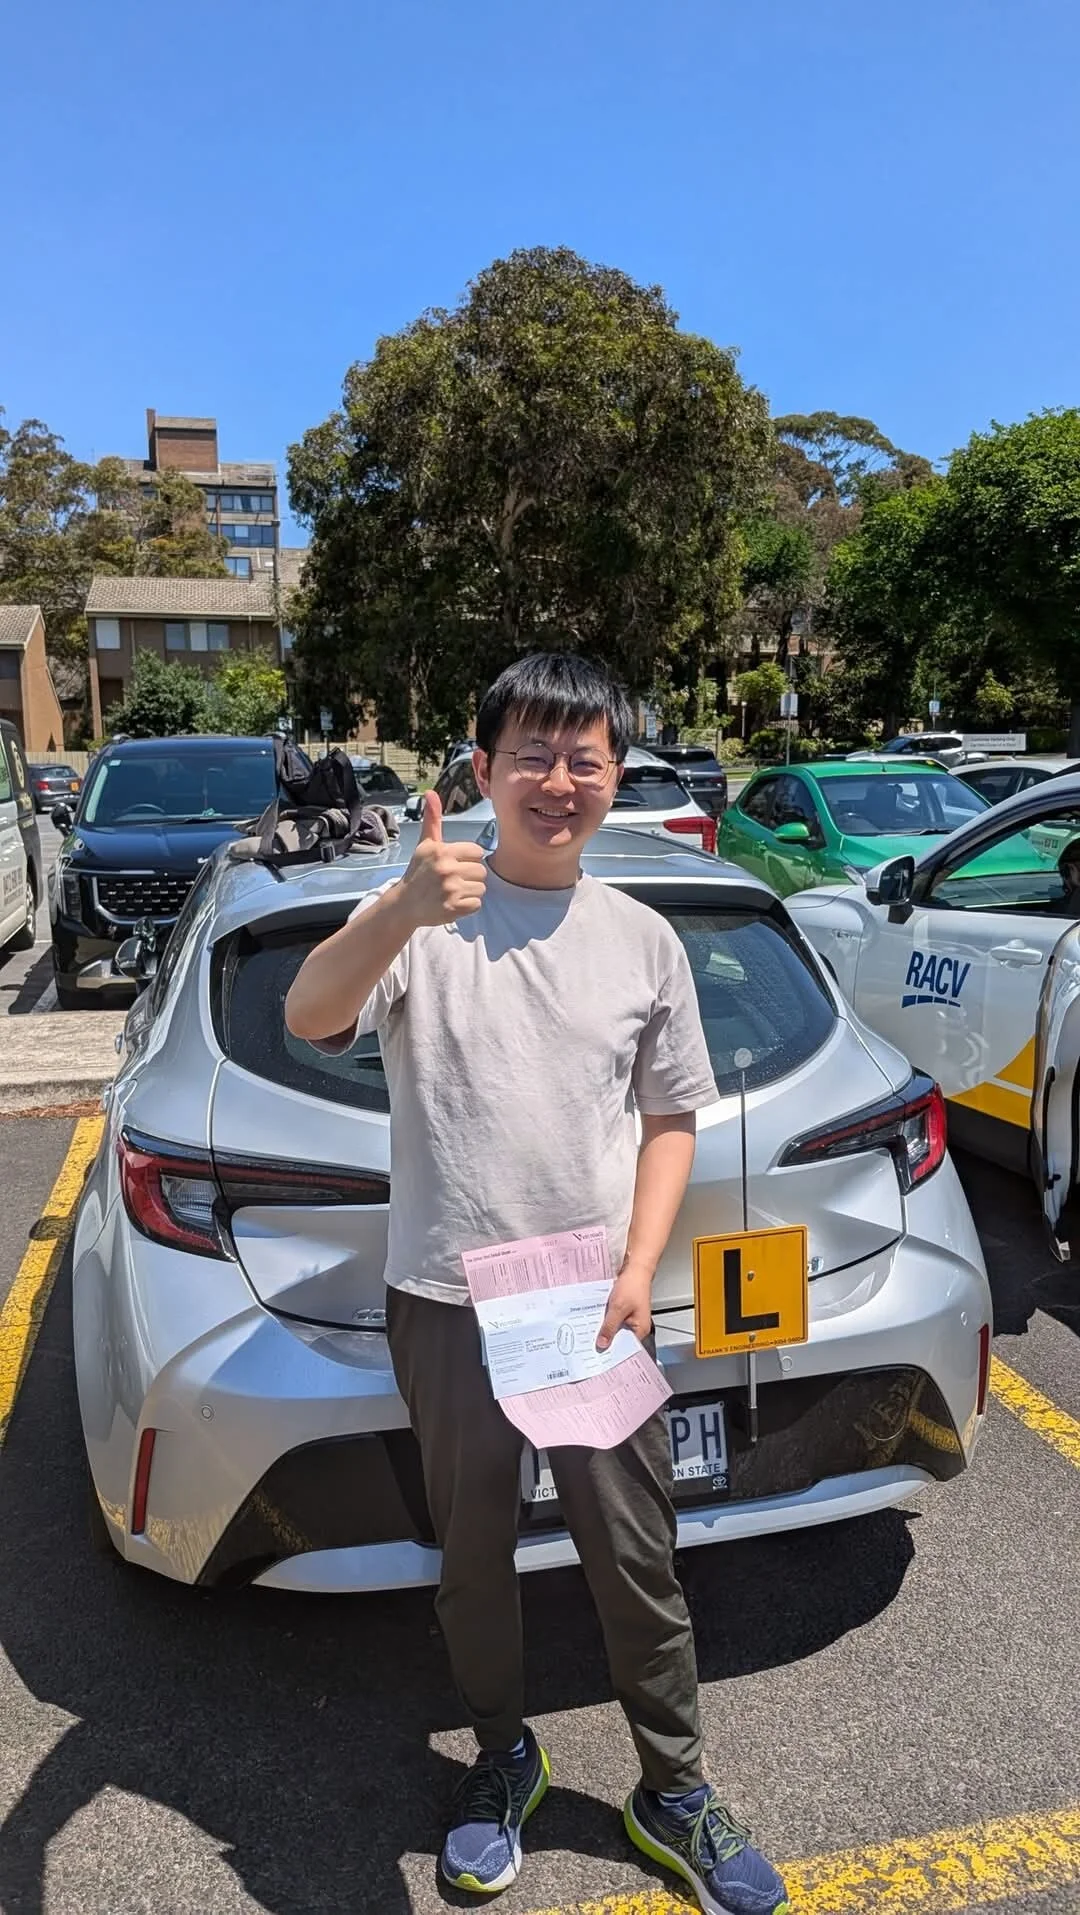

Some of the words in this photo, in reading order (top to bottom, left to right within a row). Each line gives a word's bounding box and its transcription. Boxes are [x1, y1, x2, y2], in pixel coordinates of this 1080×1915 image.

[905, 951, 971, 998] RACV
[724, 1248, 779, 1335] L
[671, 1412, 722, 1466] PH
[530, 1486, 557, 1499] VICT
[672, 1468, 684, 1478] ON
[688, 1463, 721, 1477] STATE
